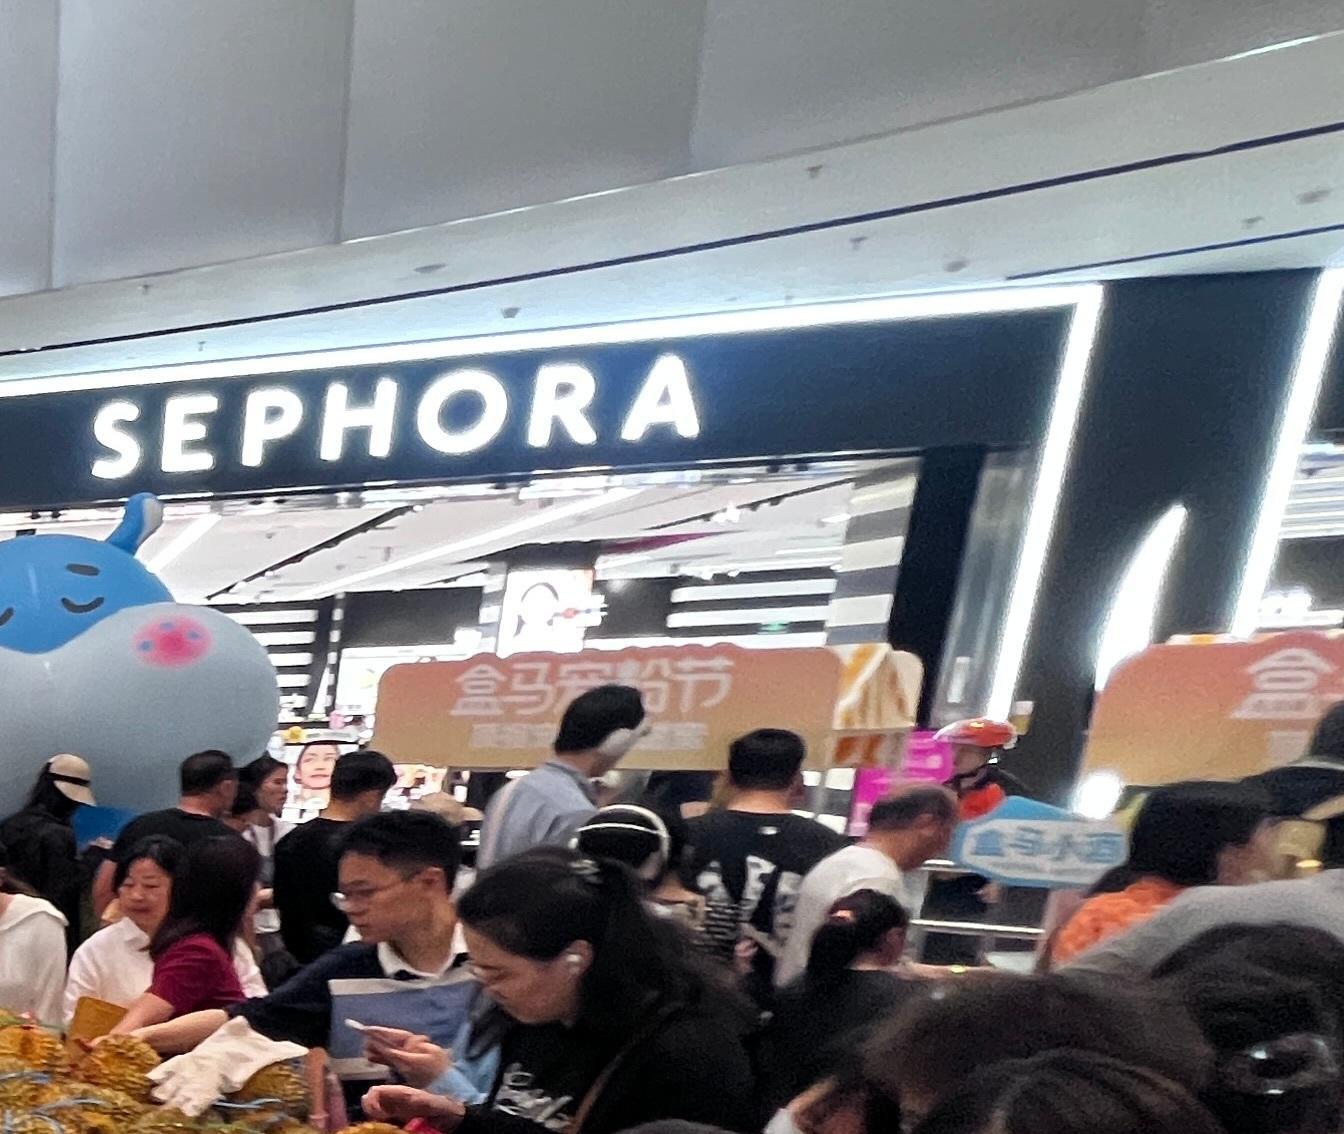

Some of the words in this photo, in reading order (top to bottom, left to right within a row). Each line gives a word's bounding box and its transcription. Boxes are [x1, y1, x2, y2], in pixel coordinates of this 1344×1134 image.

[90, 353, 701, 480] SEPHORA
[449, 655, 735, 716] 盒马宠粉节
[1229, 648, 1344, 719] 盒
